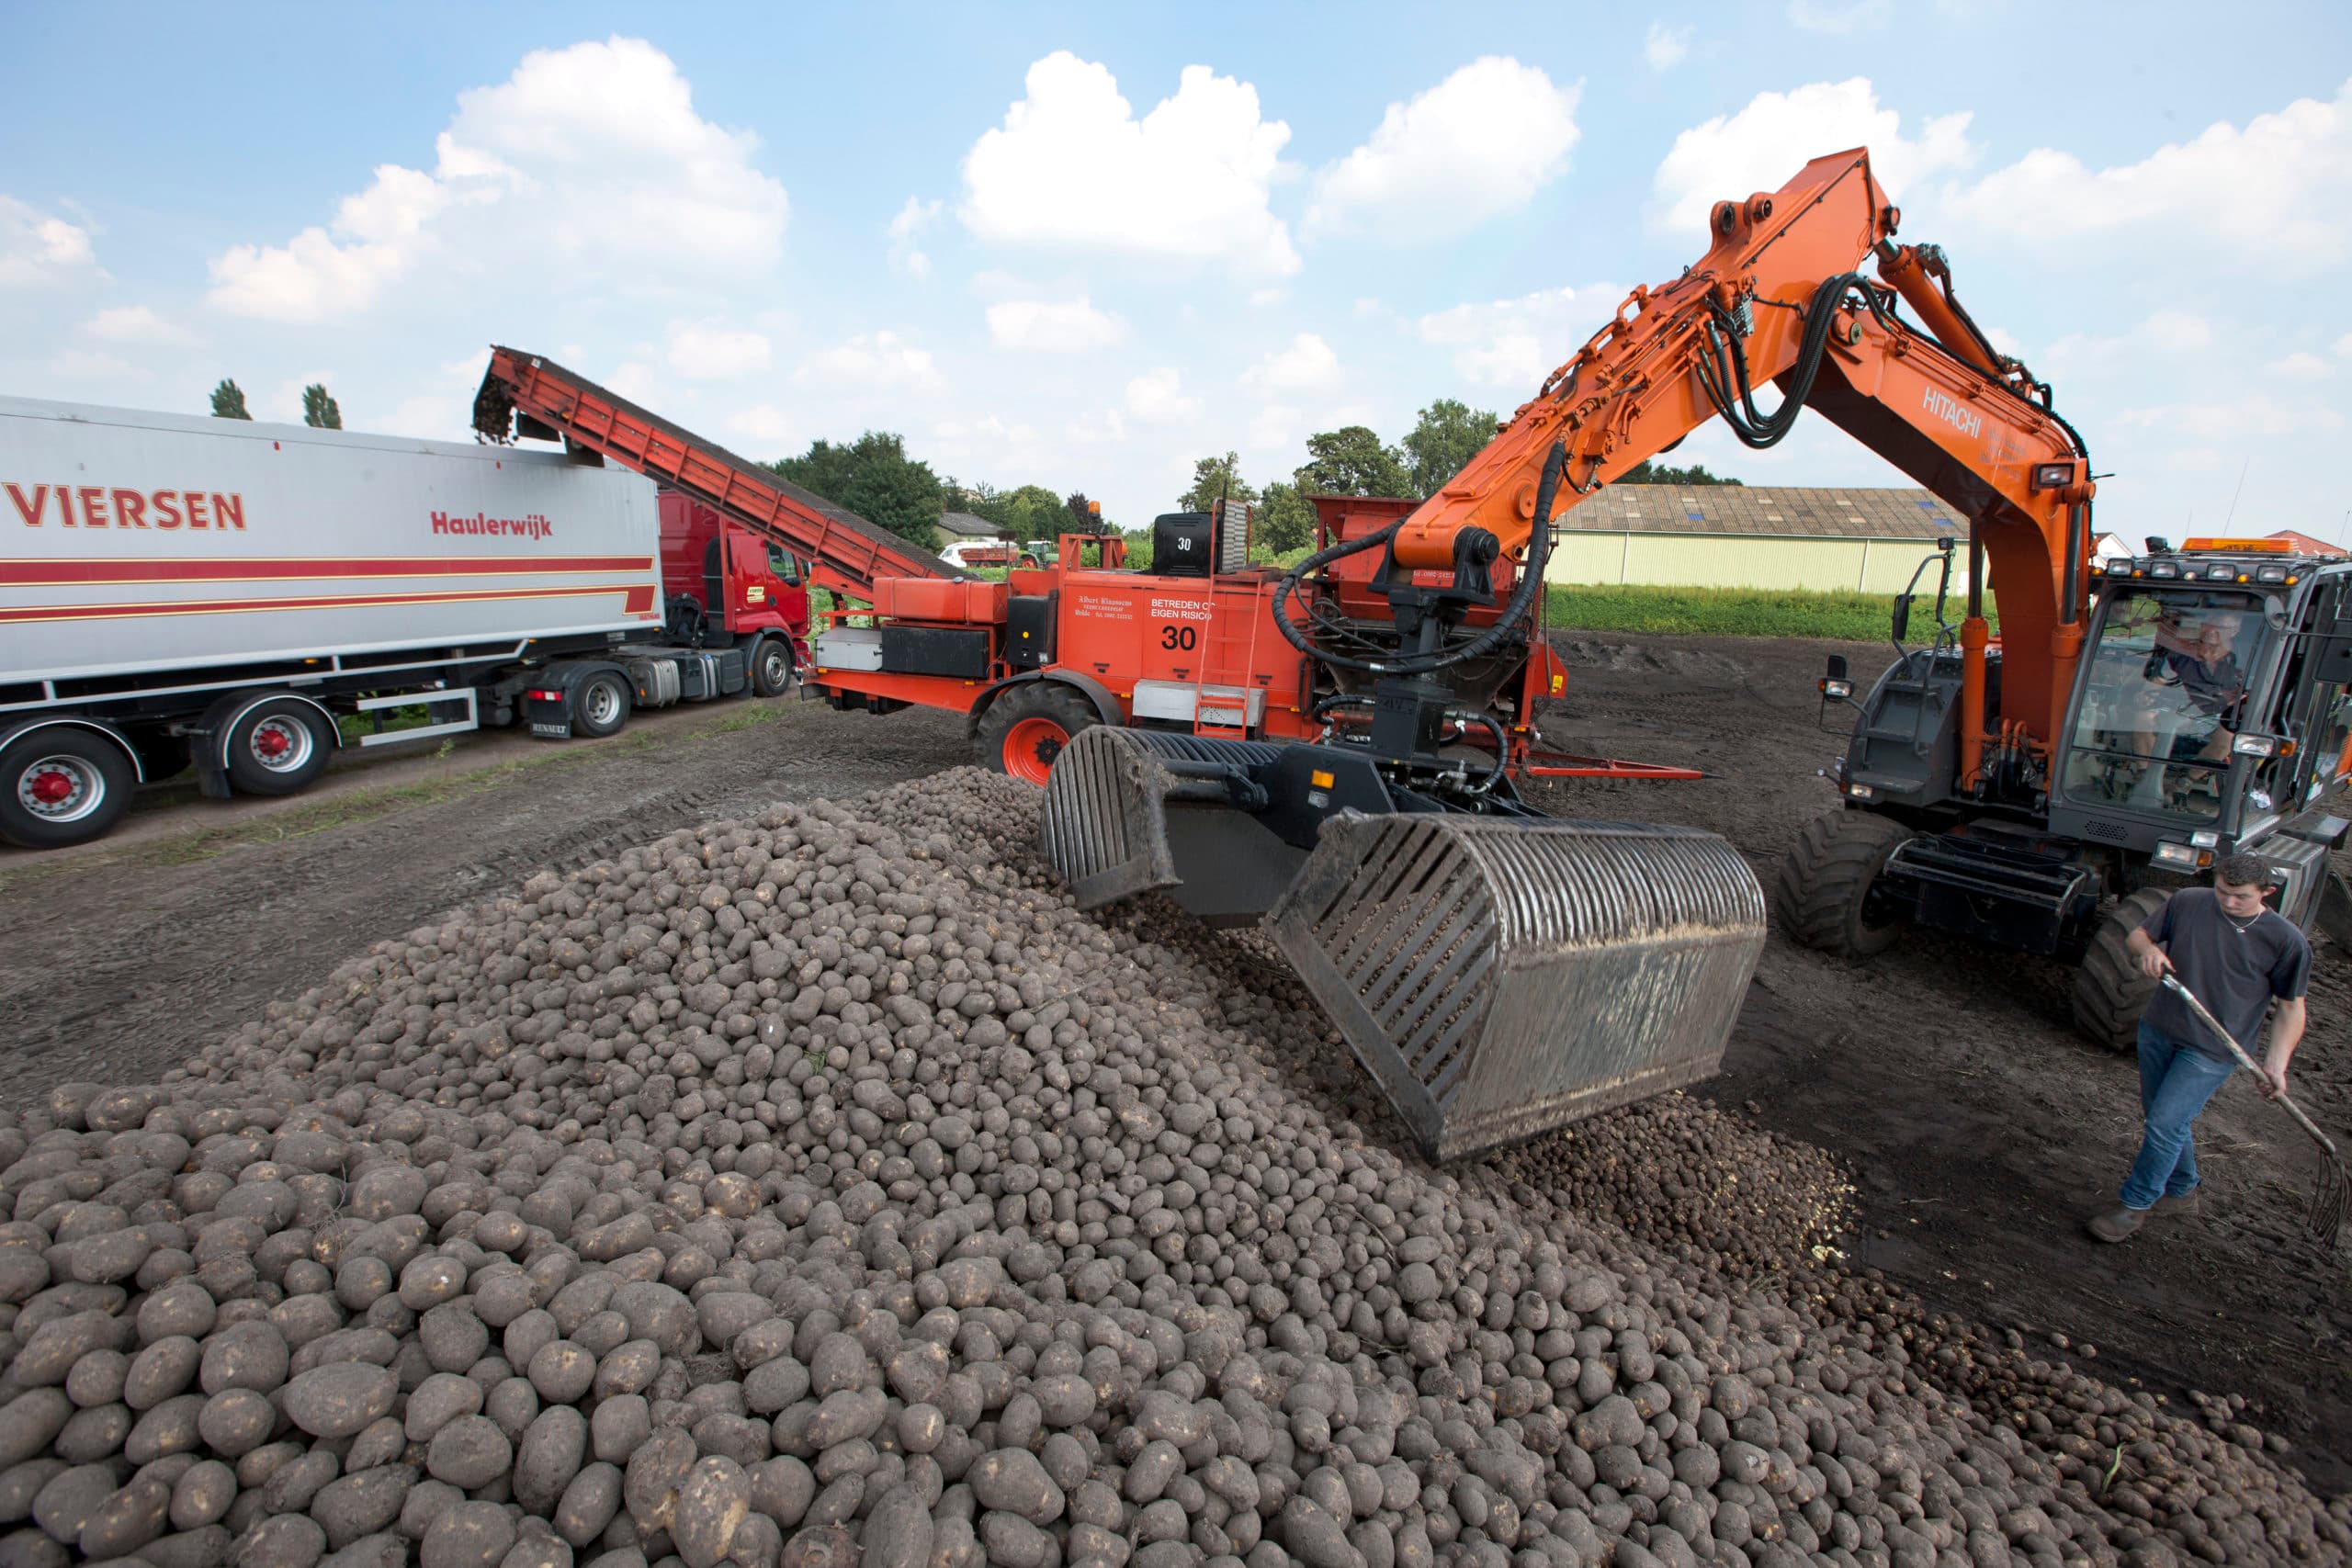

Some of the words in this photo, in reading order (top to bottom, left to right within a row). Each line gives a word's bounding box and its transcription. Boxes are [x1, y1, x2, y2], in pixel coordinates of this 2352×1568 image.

[1922, 386, 1982, 439] HITACHI
[1, 481, 246, 530] VIERSEN
[430, 511, 553, 540] Haulerwijk
[1177, 536, 1192, 551] 30
[1151, 599, 1200, 610] BETREDEN
[1151, 609, 1179, 618] EIGEN
[1181, 611, 1213, 621] RISICO
[1161, 626, 1196, 650] 30
[532, 723, 567, 734] RENAULT
